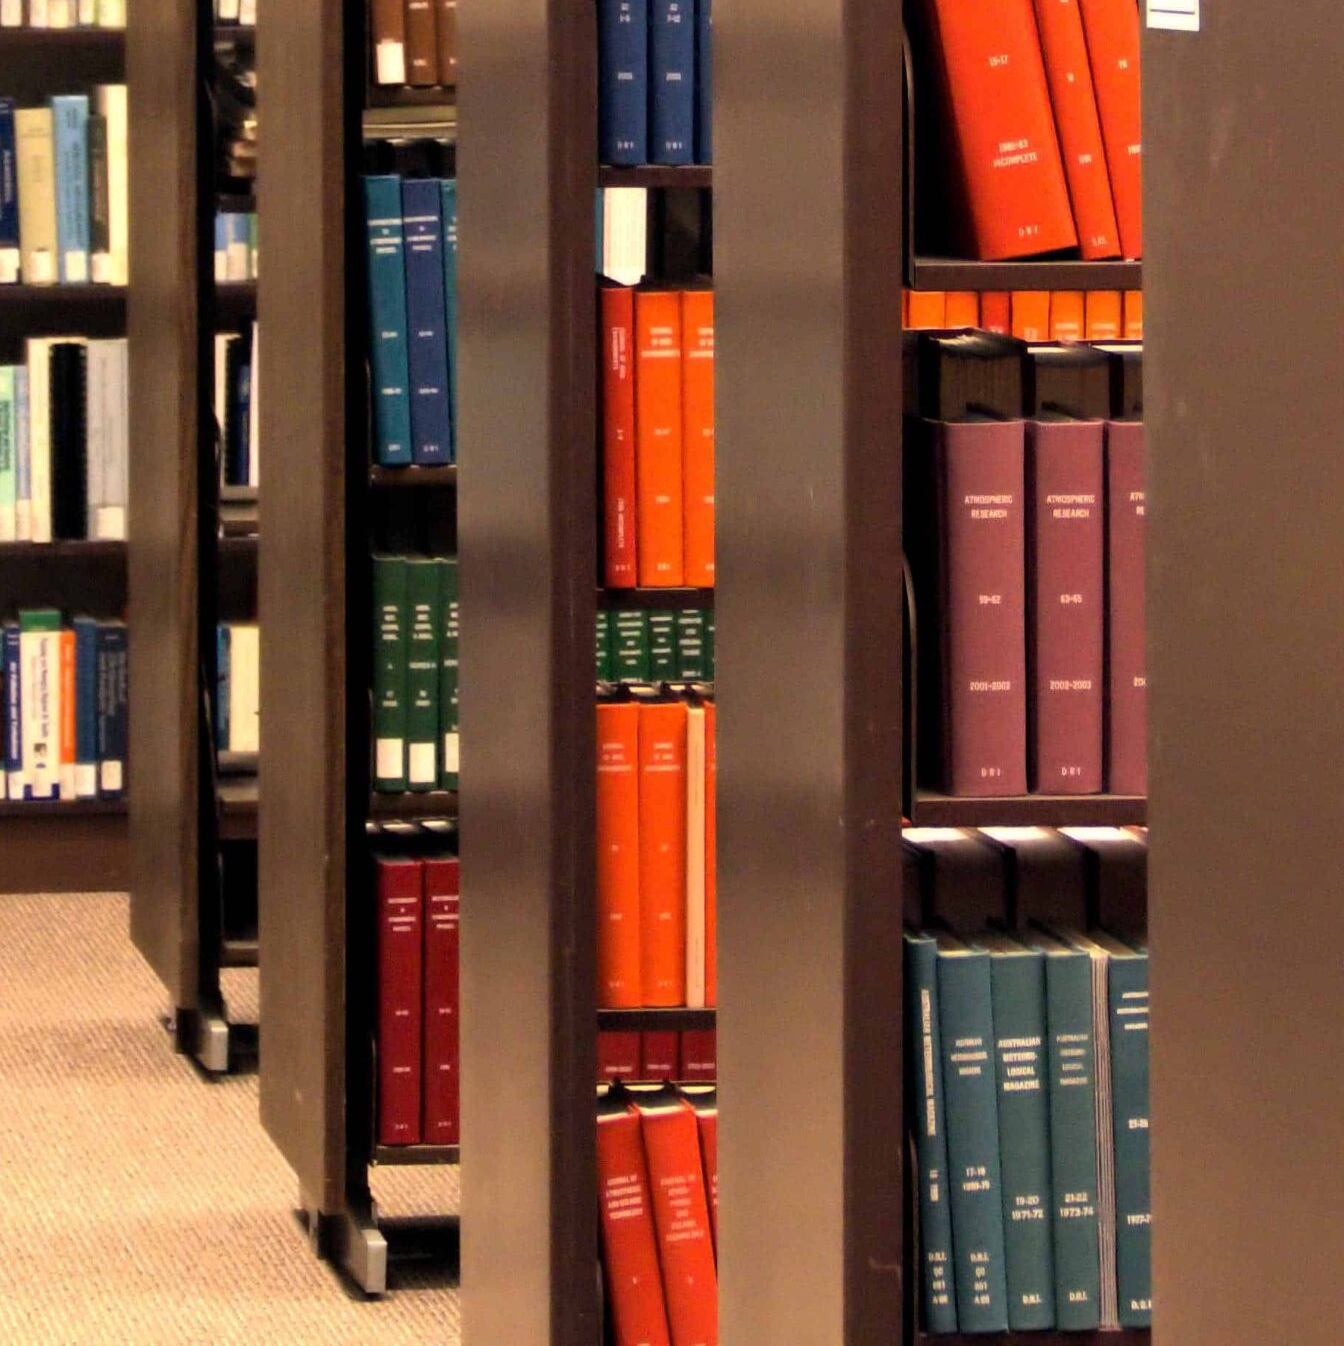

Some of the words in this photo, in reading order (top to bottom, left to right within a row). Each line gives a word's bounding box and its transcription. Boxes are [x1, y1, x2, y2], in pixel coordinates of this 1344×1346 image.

[965, 494, 1013, 505] ATMOSPHERIC
[1046, 494, 1095, 504] ATMOSPHERIC
[971, 509, 1007, 519] RESEARCH
[1053, 509, 1089, 518] RESEARCH
[998, 1037, 1041, 1048] AUSTRALIAN
[1007, 1066, 1035, 1076] LOGICAL
